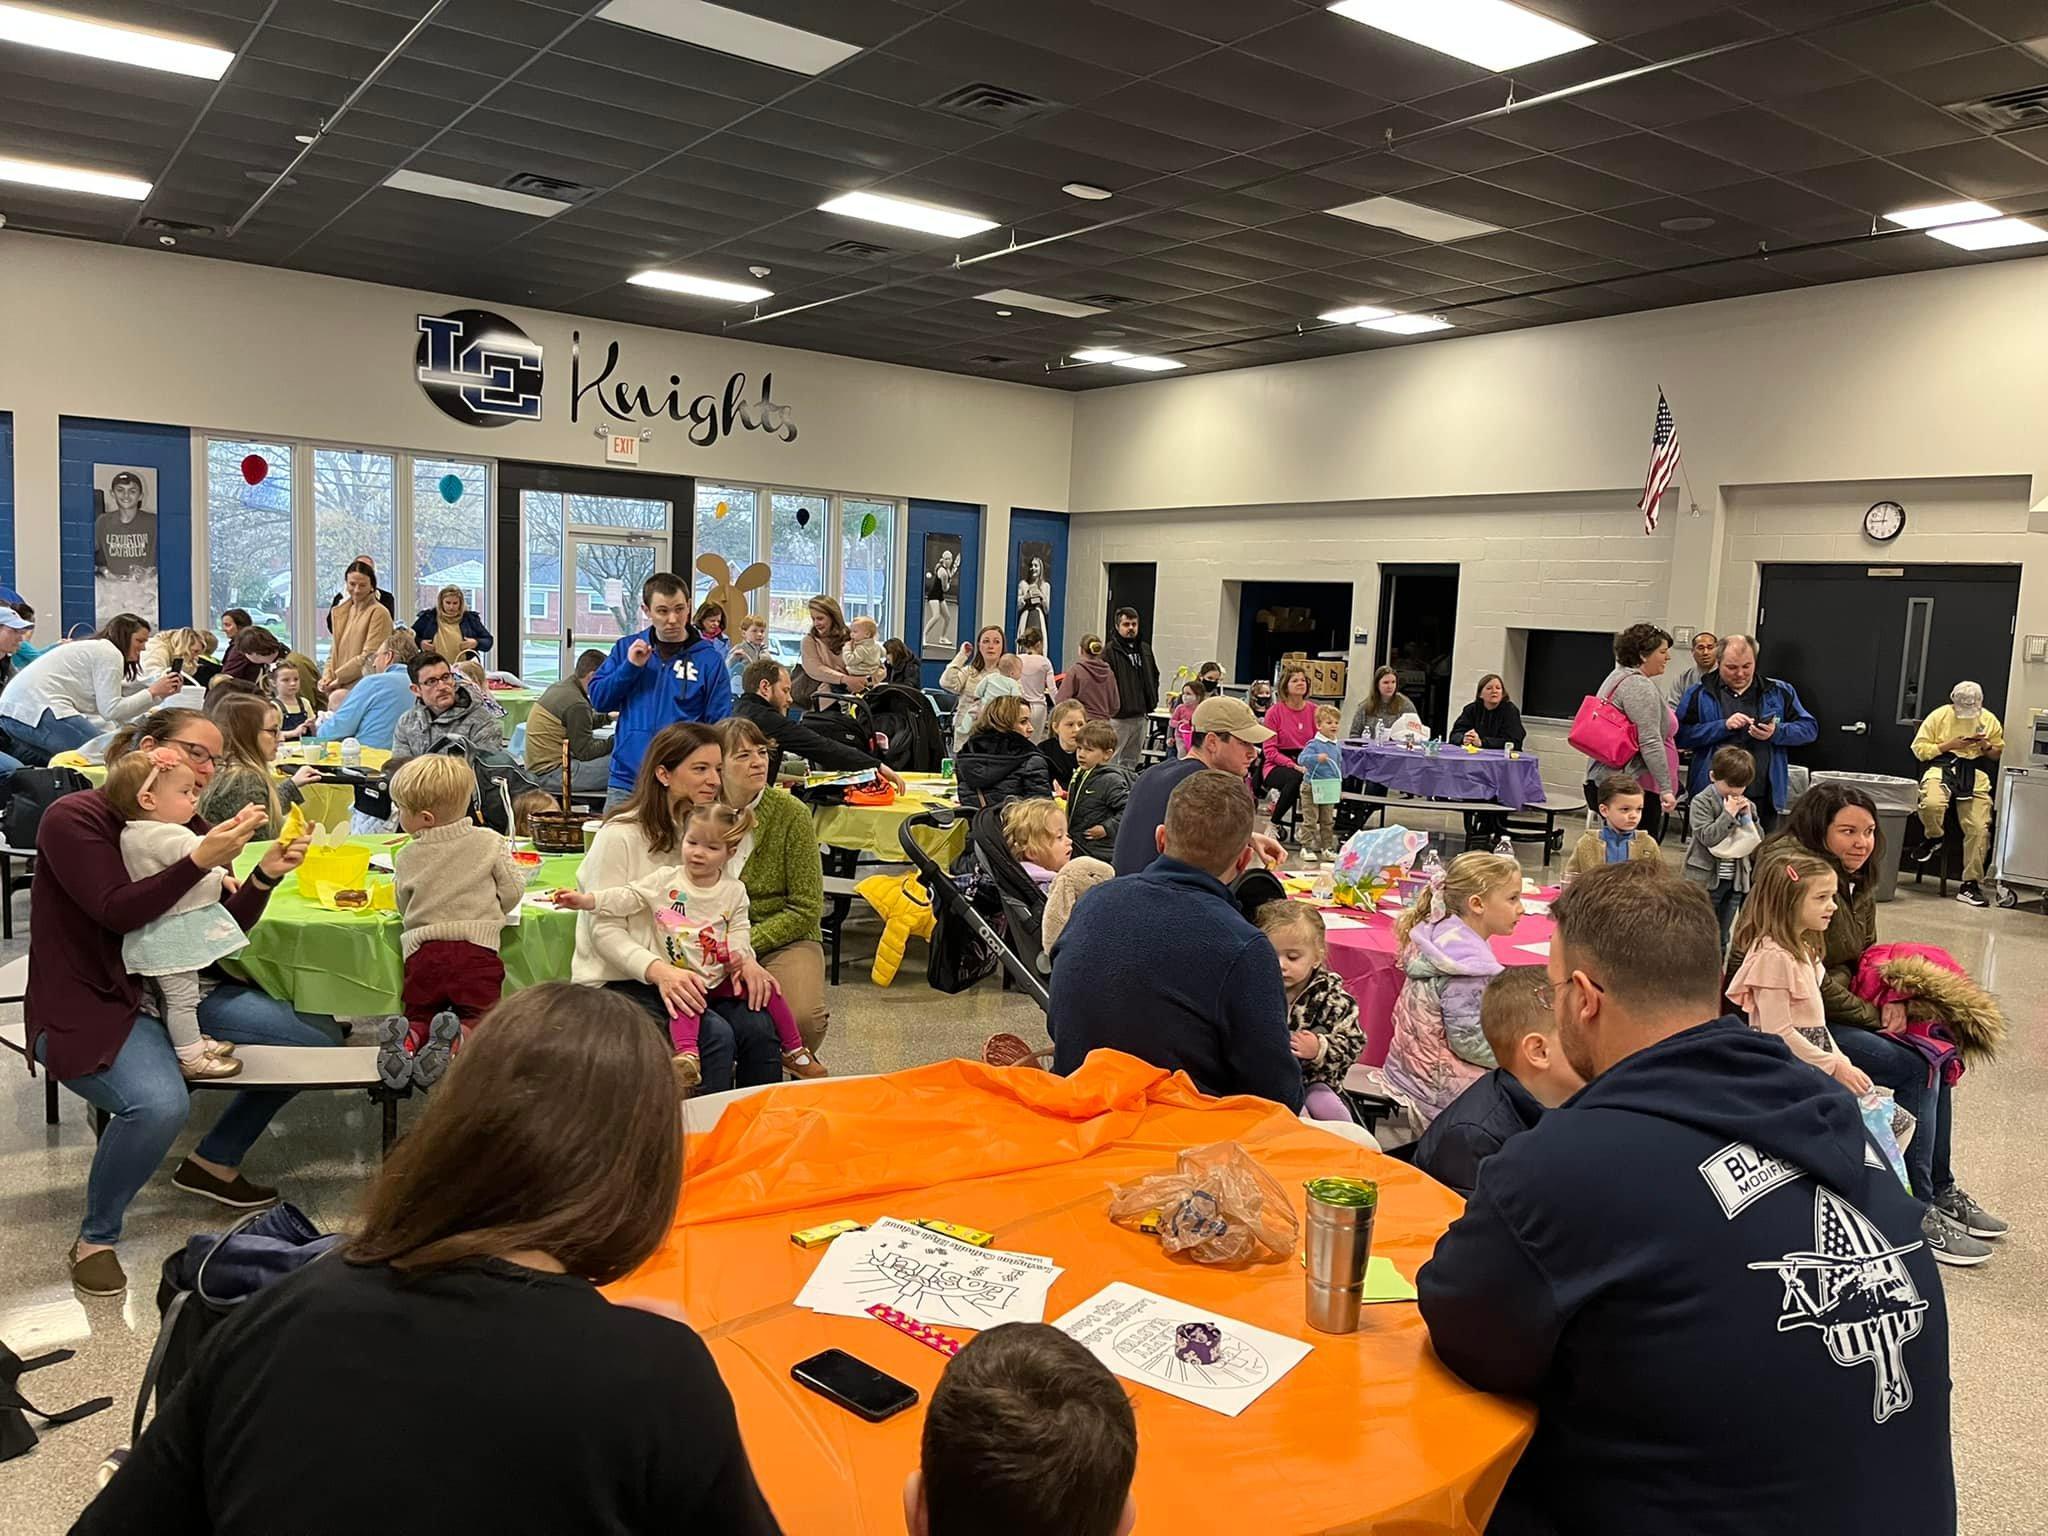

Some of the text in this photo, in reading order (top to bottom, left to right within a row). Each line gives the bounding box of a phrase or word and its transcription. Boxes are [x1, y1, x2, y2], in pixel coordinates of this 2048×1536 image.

[417, 314, 798, 447] LC Knights
[614, 437, 635, 455] EXIT
[1724, 1147, 1774, 1182] BLA
[1738, 1160, 1795, 1195] MODIFIC
